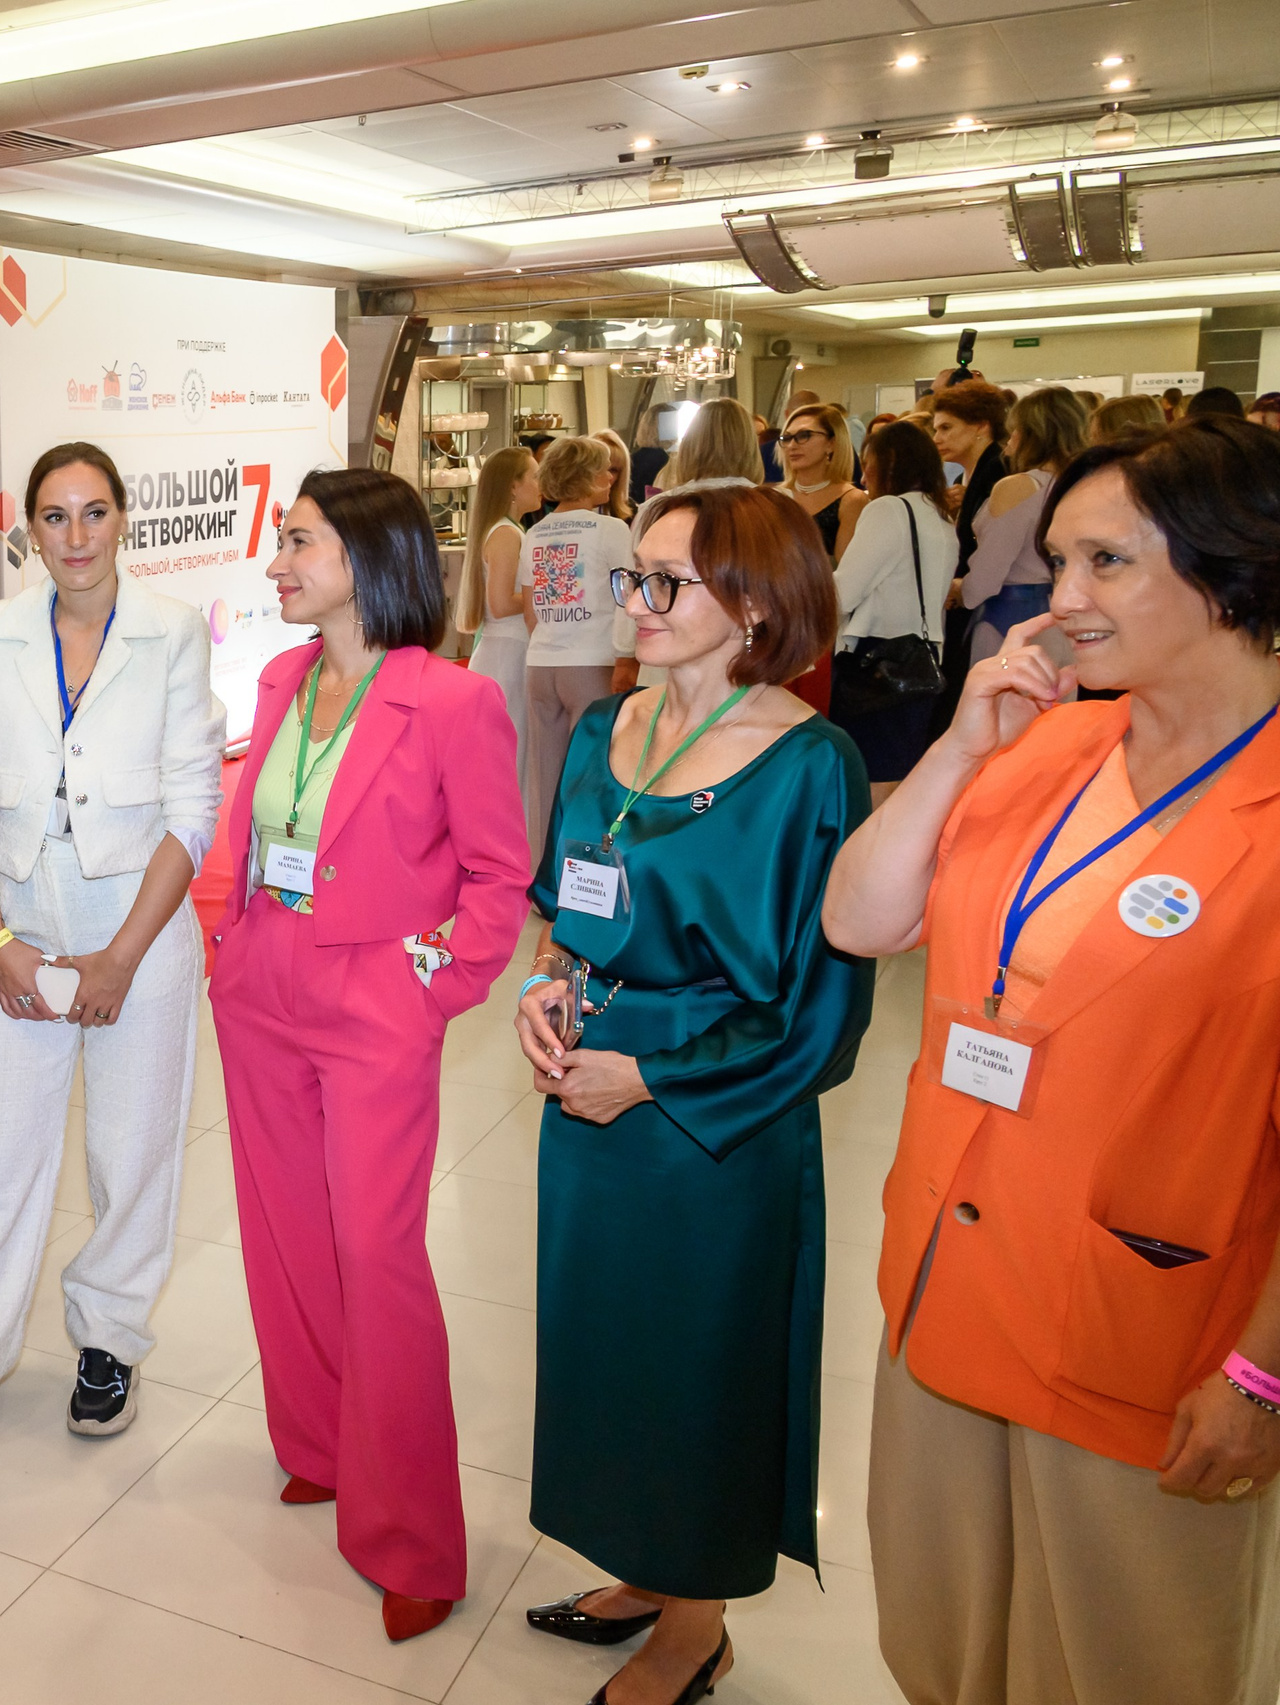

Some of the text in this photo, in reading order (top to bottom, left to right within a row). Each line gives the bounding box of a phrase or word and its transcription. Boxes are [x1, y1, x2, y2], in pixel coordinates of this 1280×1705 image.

[176, 339, 190, 351] ПРИ
[122, 458, 238, 513] БОЛЬШОЙ
[242, 463, 271, 560] 7
[124, 509, 237, 551] НЕТВОРКИНГ
[127, 549, 239, 578] БОЛЬШОЙ_НЕТВОРКИНГ_МБМ
[956, 1049, 1013, 1076] КАЛГАНОВА
[966, 1040, 1009, 1062] ТАТЬЯНА
